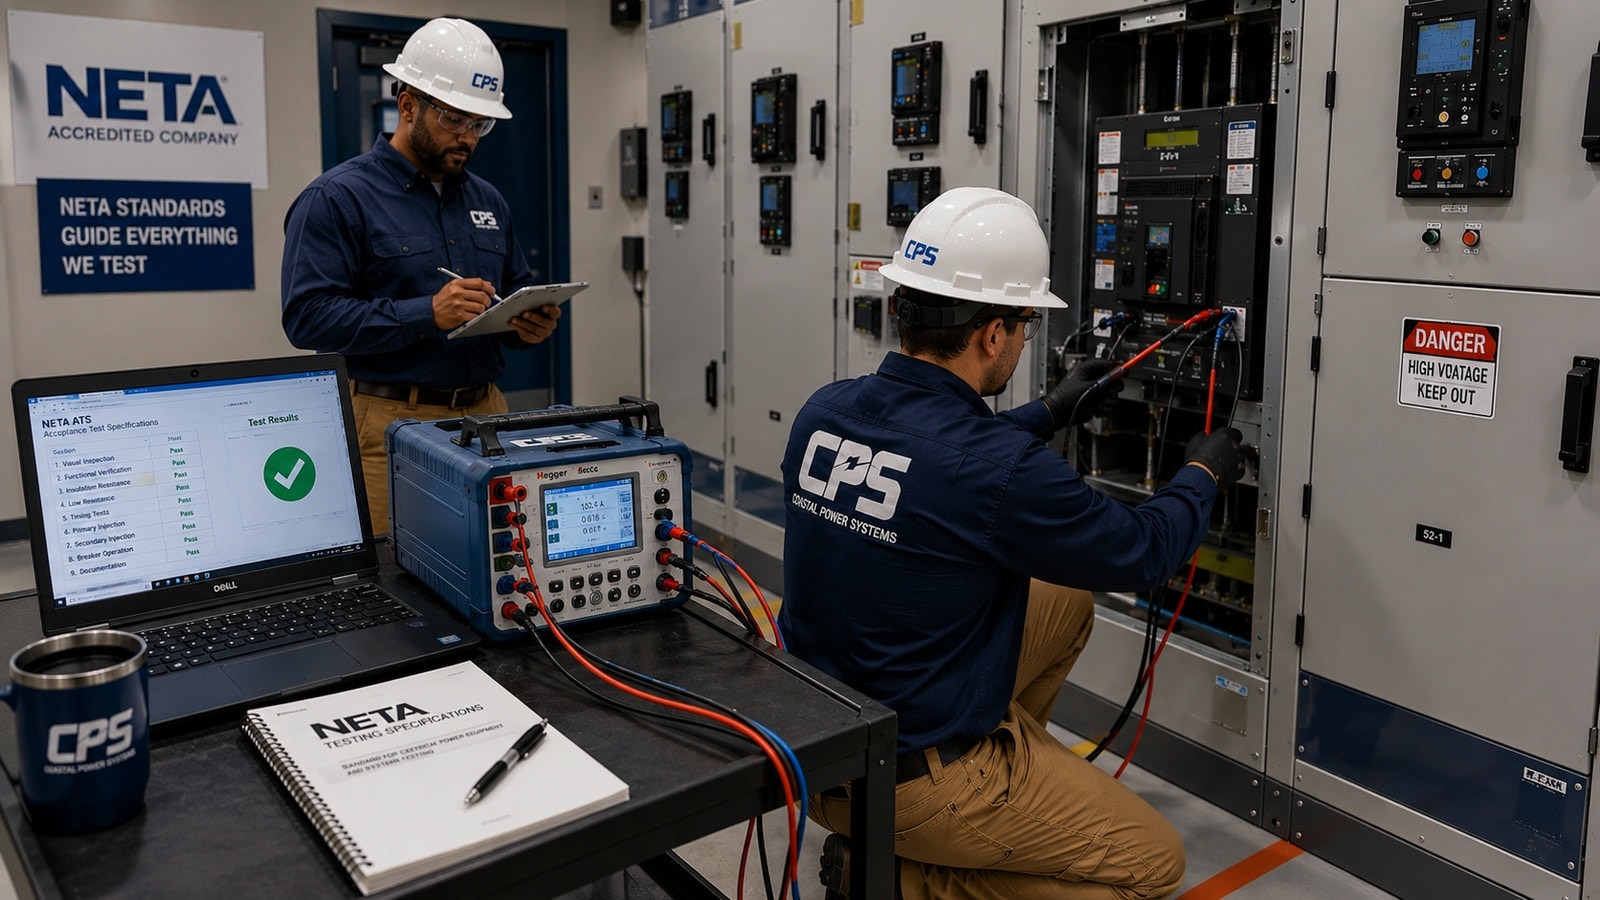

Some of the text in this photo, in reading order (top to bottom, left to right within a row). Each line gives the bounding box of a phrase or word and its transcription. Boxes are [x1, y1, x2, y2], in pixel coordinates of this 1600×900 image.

[471, 72, 499, 92] CPS
[47, 125, 239, 146] ACCREDITED COMPANY
[59, 197, 226, 217] NETA STANDARDS
[469, 210, 497, 225] CPS
[61, 226, 238, 245] GUIDE EVERYTHING
[904, 239, 939, 266] CPS
[62, 255, 148, 275] WE TEST
[1414, 328, 1486, 354] DANGER
[1407, 359, 1435, 377] HIGH
[1417, 382, 1476, 406] KEEP OUT
[41, 415, 92, 428] NETA ATS
[89, 424, 106, 433] Test
[247, 413, 299, 427] Test Results
[798, 430, 912, 521] CPS
[92, 509, 110, 517] Tests
[792, 492, 898, 544] COASTAL POWER SYSTEMS
[1423, 528, 1443, 543] 52-1
[79, 561, 127, 575] Documentation
[310, 702, 430, 740] NETA
[324, 704, 484, 750] TESTING SPECIFICATIONS
[46, 707, 134, 764] CPS
[78, 760, 106, 772] POWER
